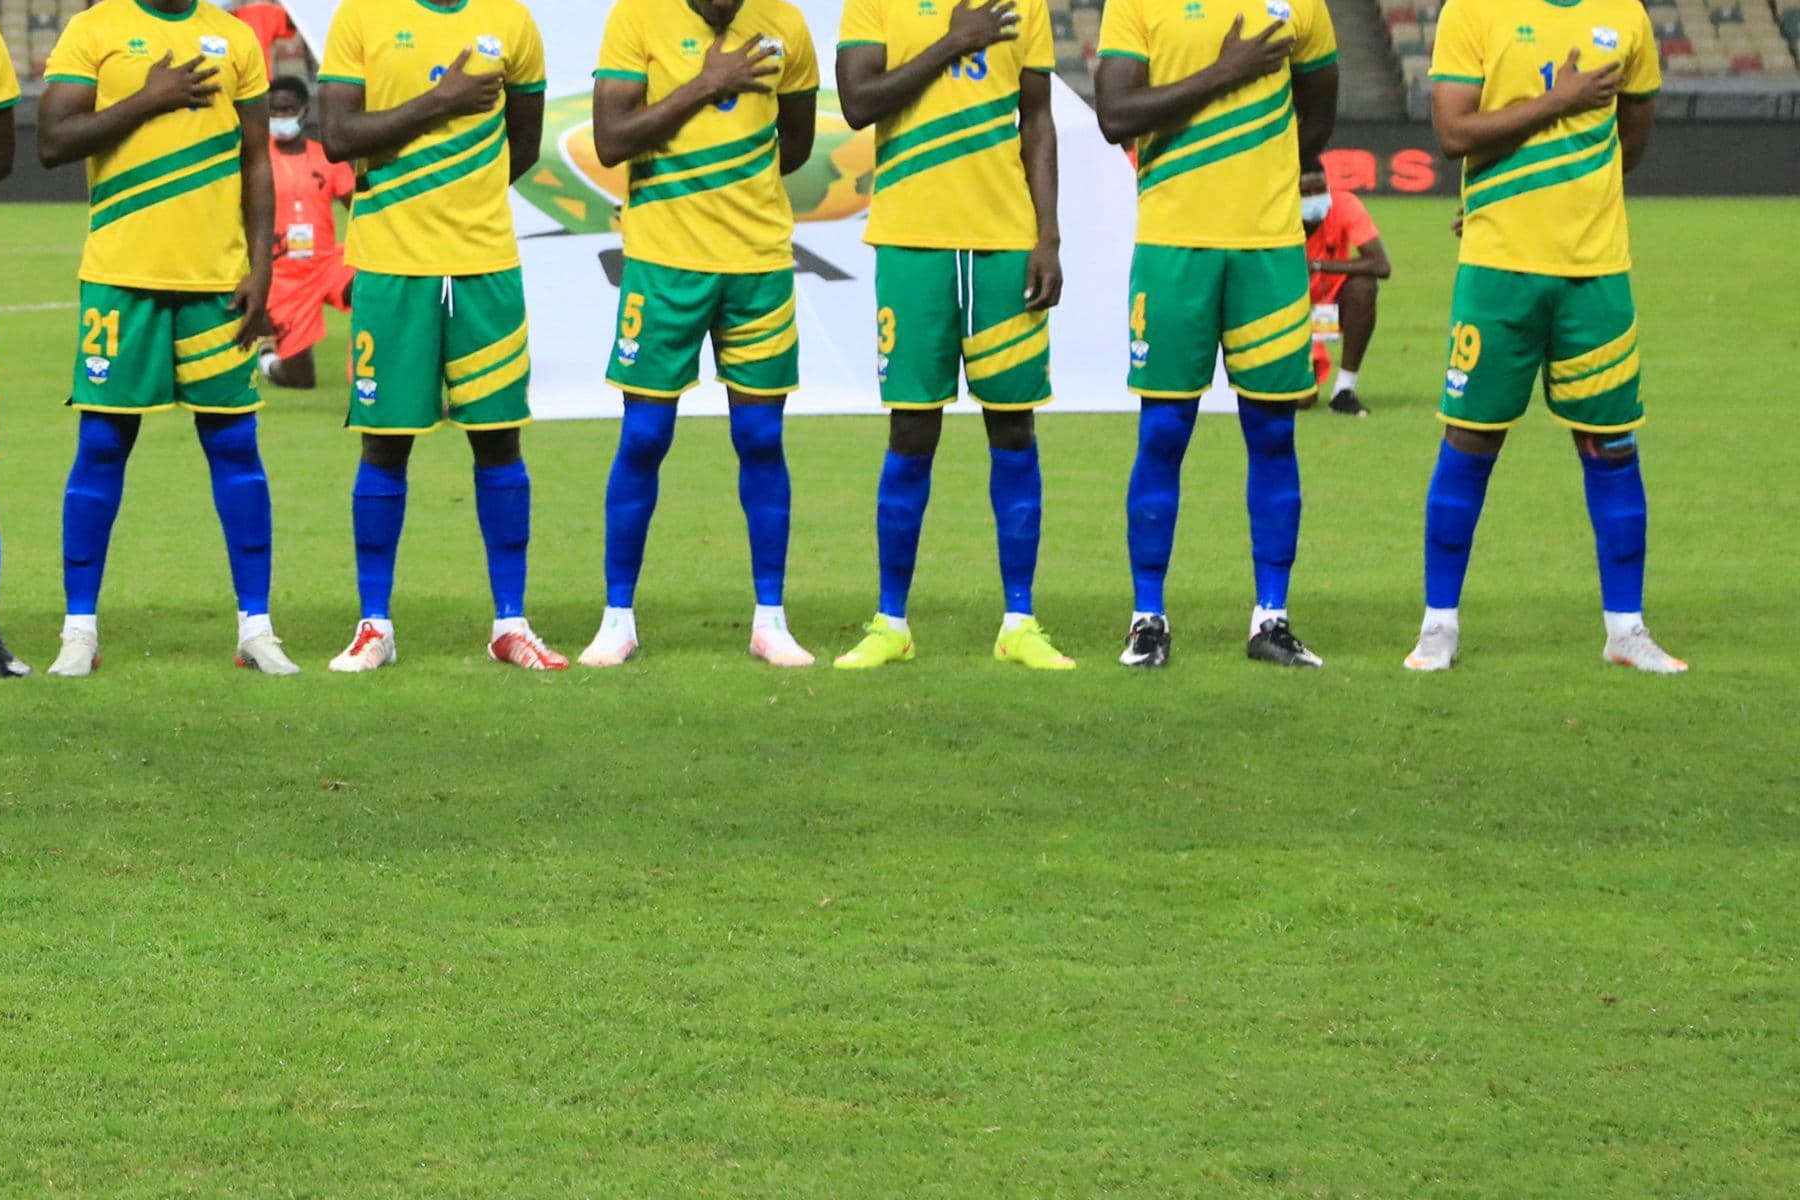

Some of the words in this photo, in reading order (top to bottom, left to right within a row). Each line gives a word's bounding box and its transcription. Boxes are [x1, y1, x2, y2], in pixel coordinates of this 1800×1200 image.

[82, 307, 120, 356] 21
[621, 292, 645, 339] 5
[1130, 292, 1146, 340] 4
[356, 331, 375, 377] 2
[1450, 320, 1481, 372] 19
